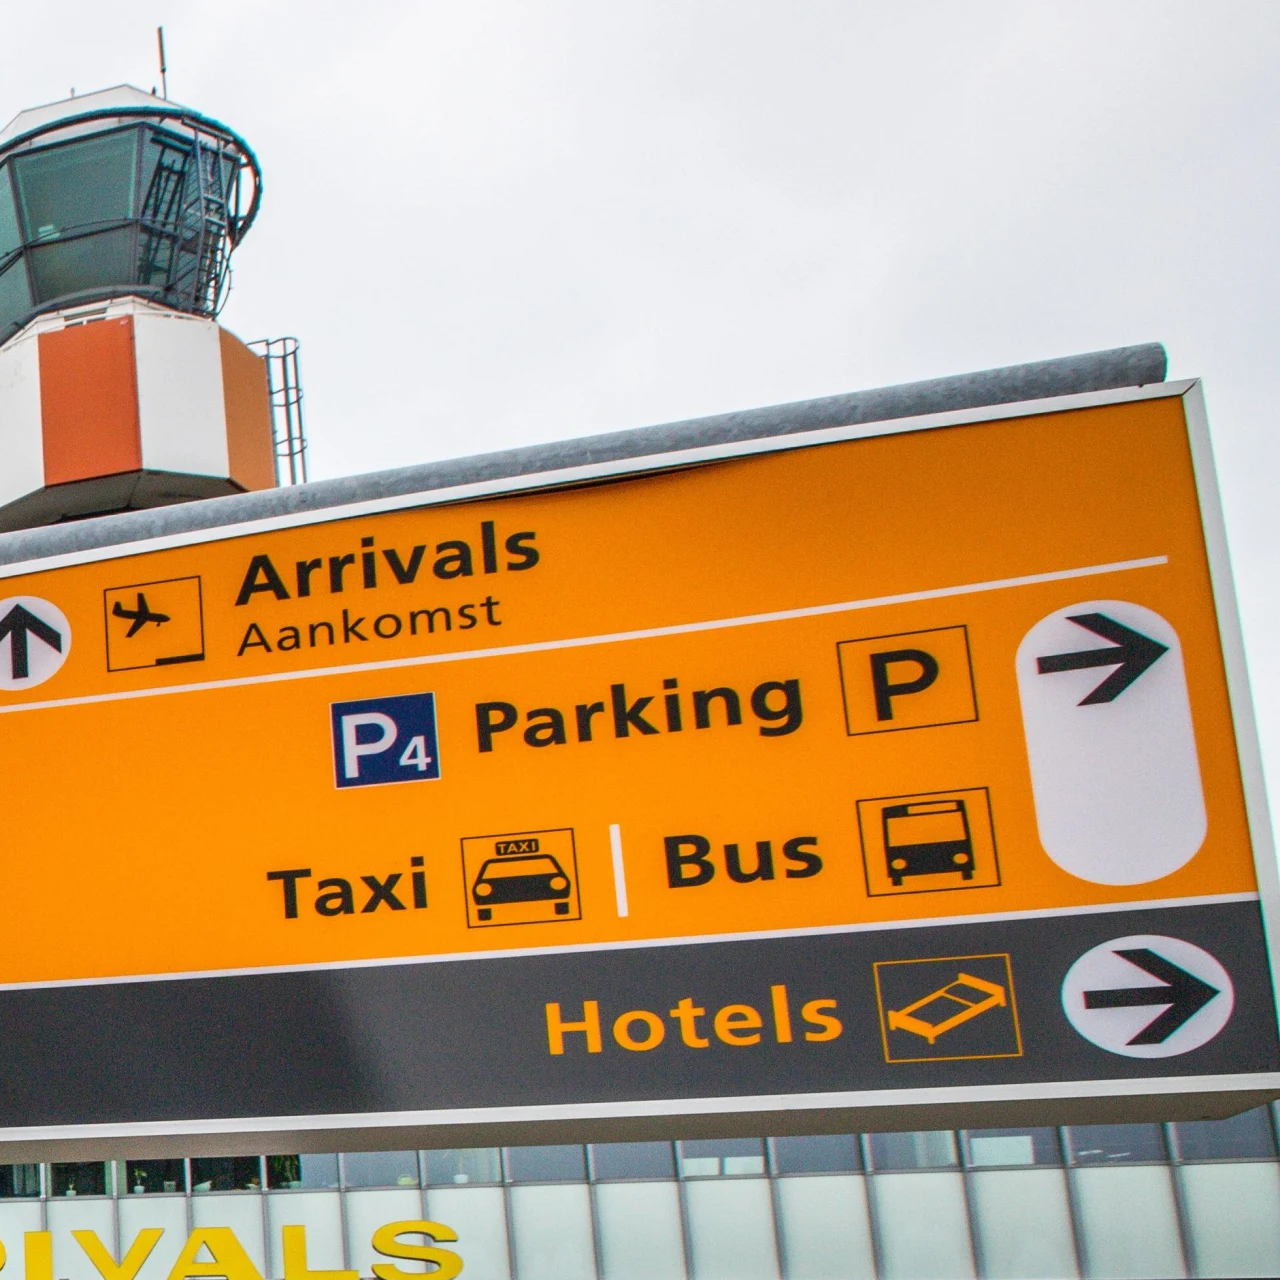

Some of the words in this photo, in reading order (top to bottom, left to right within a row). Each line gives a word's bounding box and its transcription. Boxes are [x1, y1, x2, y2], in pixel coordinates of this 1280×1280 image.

[235, 520, 539, 606] Arrivals
[236, 596, 501, 656] Aankomst
[342, 713, 431, 778] P4
[476, 678, 803, 752] Parking
[870, 649, 939, 721] P
[268, 857, 427, 919] Taxi
[665, 835, 822, 889] Bus
[497, 842, 537, 854] TAXI
[545, 985, 844, 1056] Hotels
